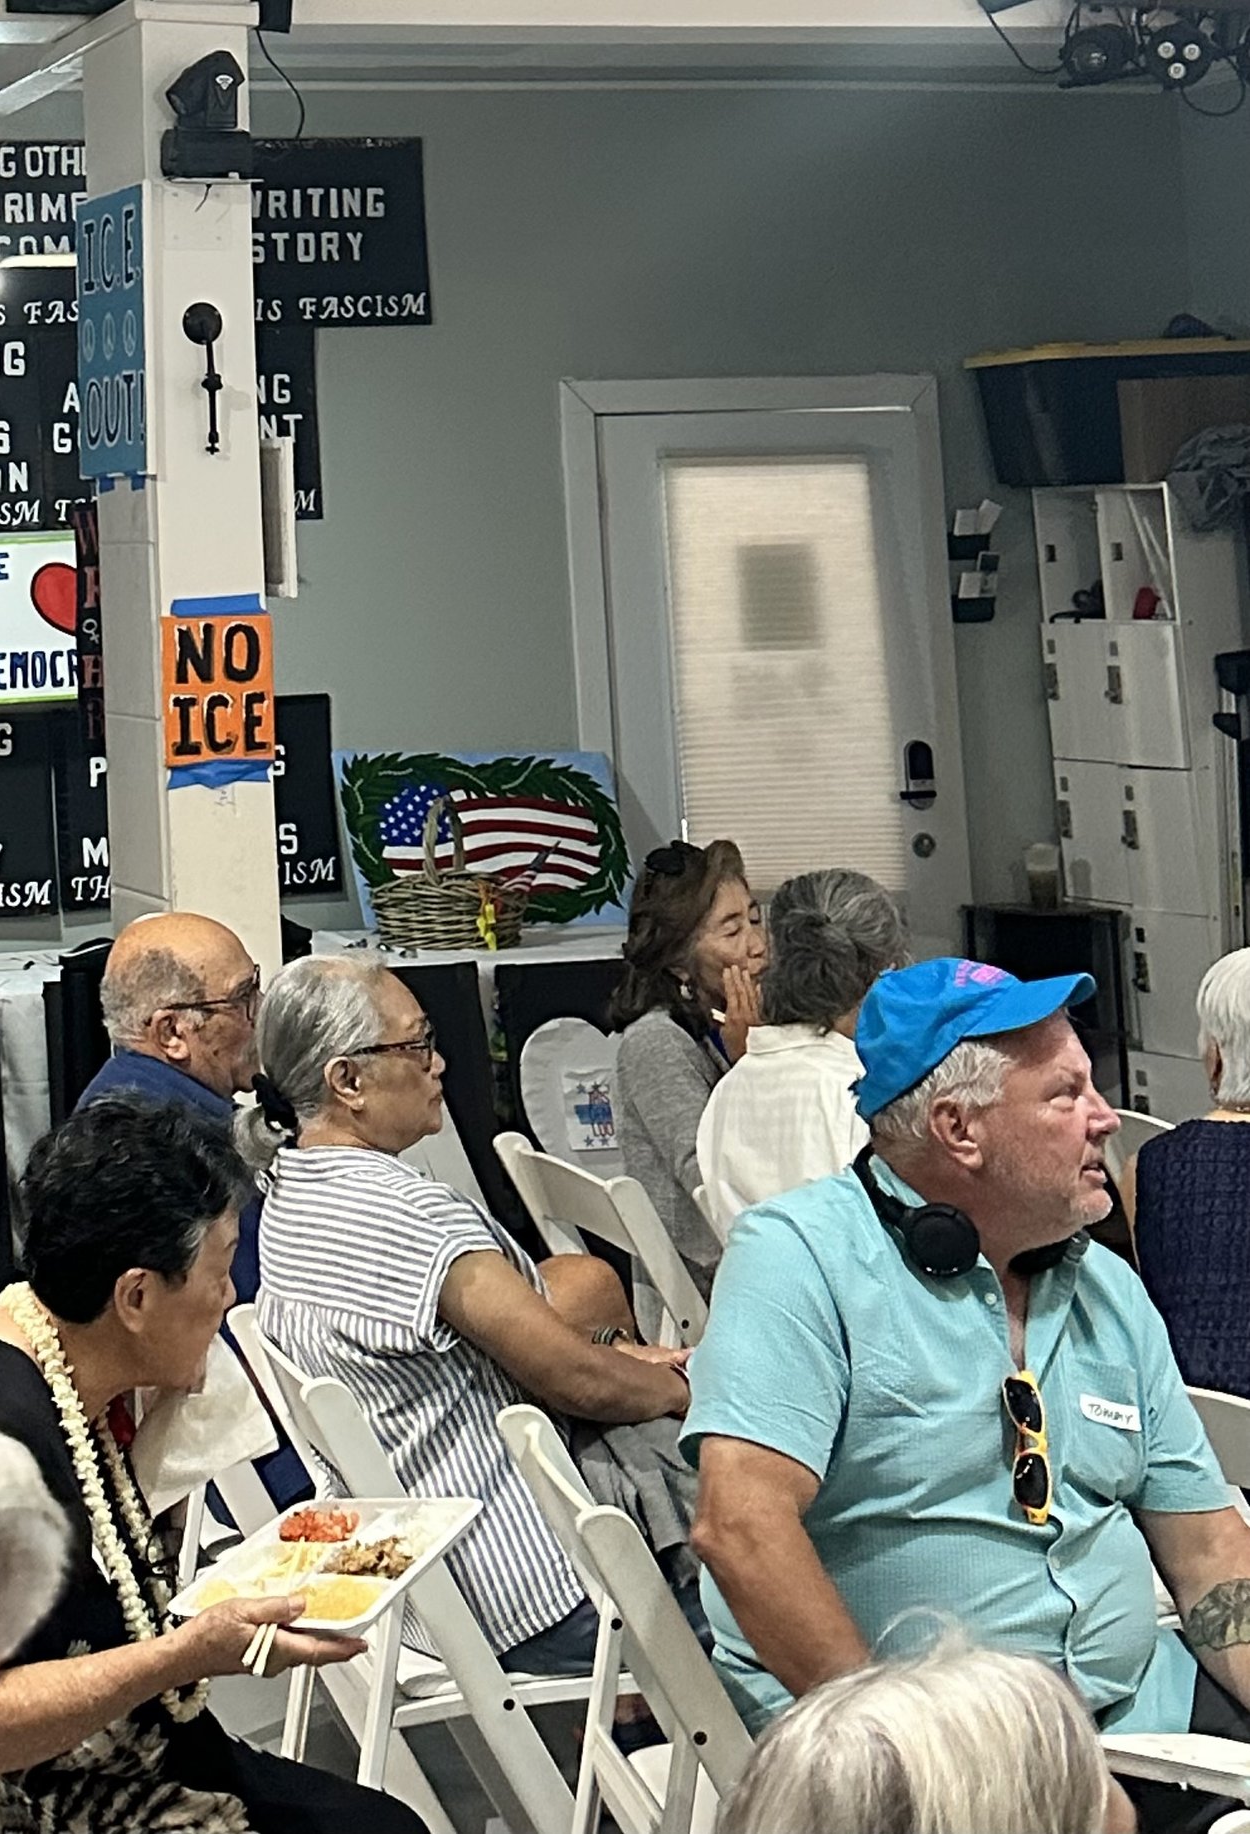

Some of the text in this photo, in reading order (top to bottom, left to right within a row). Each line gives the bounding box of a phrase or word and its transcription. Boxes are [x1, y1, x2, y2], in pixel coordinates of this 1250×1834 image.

[255, 291, 427, 322] IS FASCISM
[173, 621, 261, 685] NO
[169, 690, 270, 756] ICE
